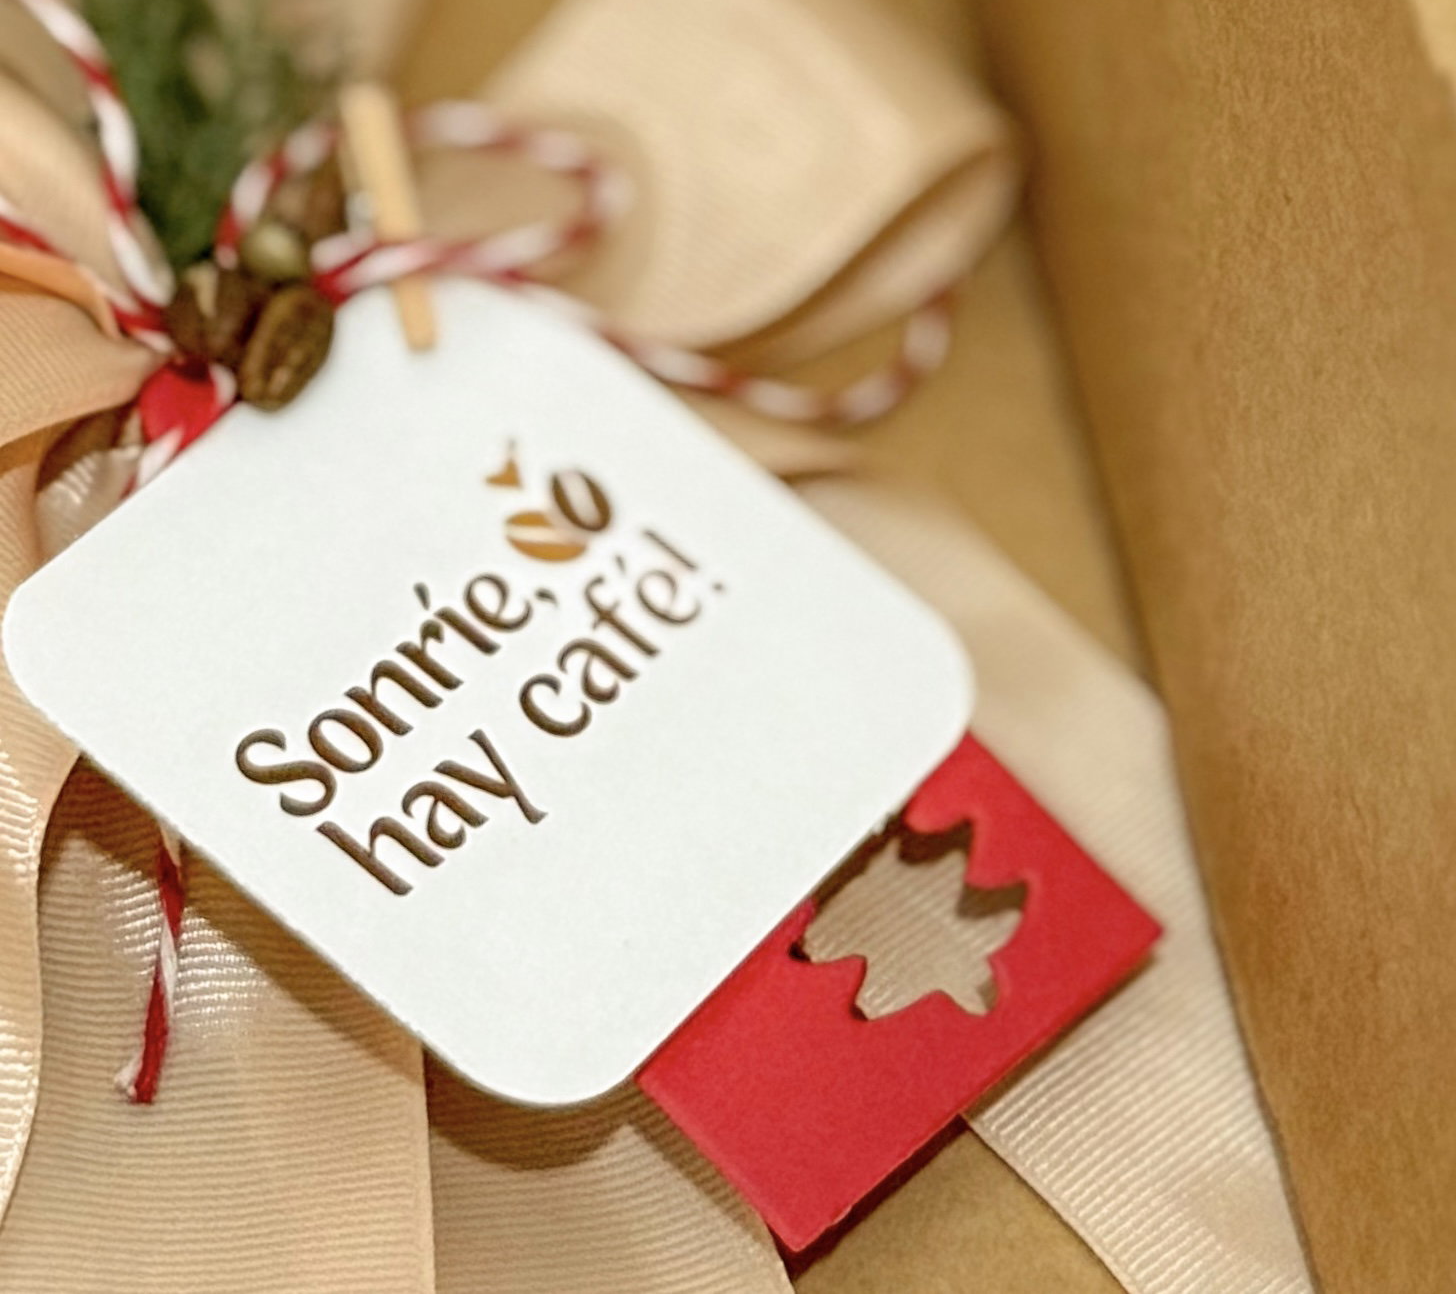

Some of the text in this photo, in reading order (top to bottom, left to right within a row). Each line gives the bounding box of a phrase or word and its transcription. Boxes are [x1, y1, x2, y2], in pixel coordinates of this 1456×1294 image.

[234, 573, 558, 818] Sonríe,
[315, 529, 728, 897] hay café!
